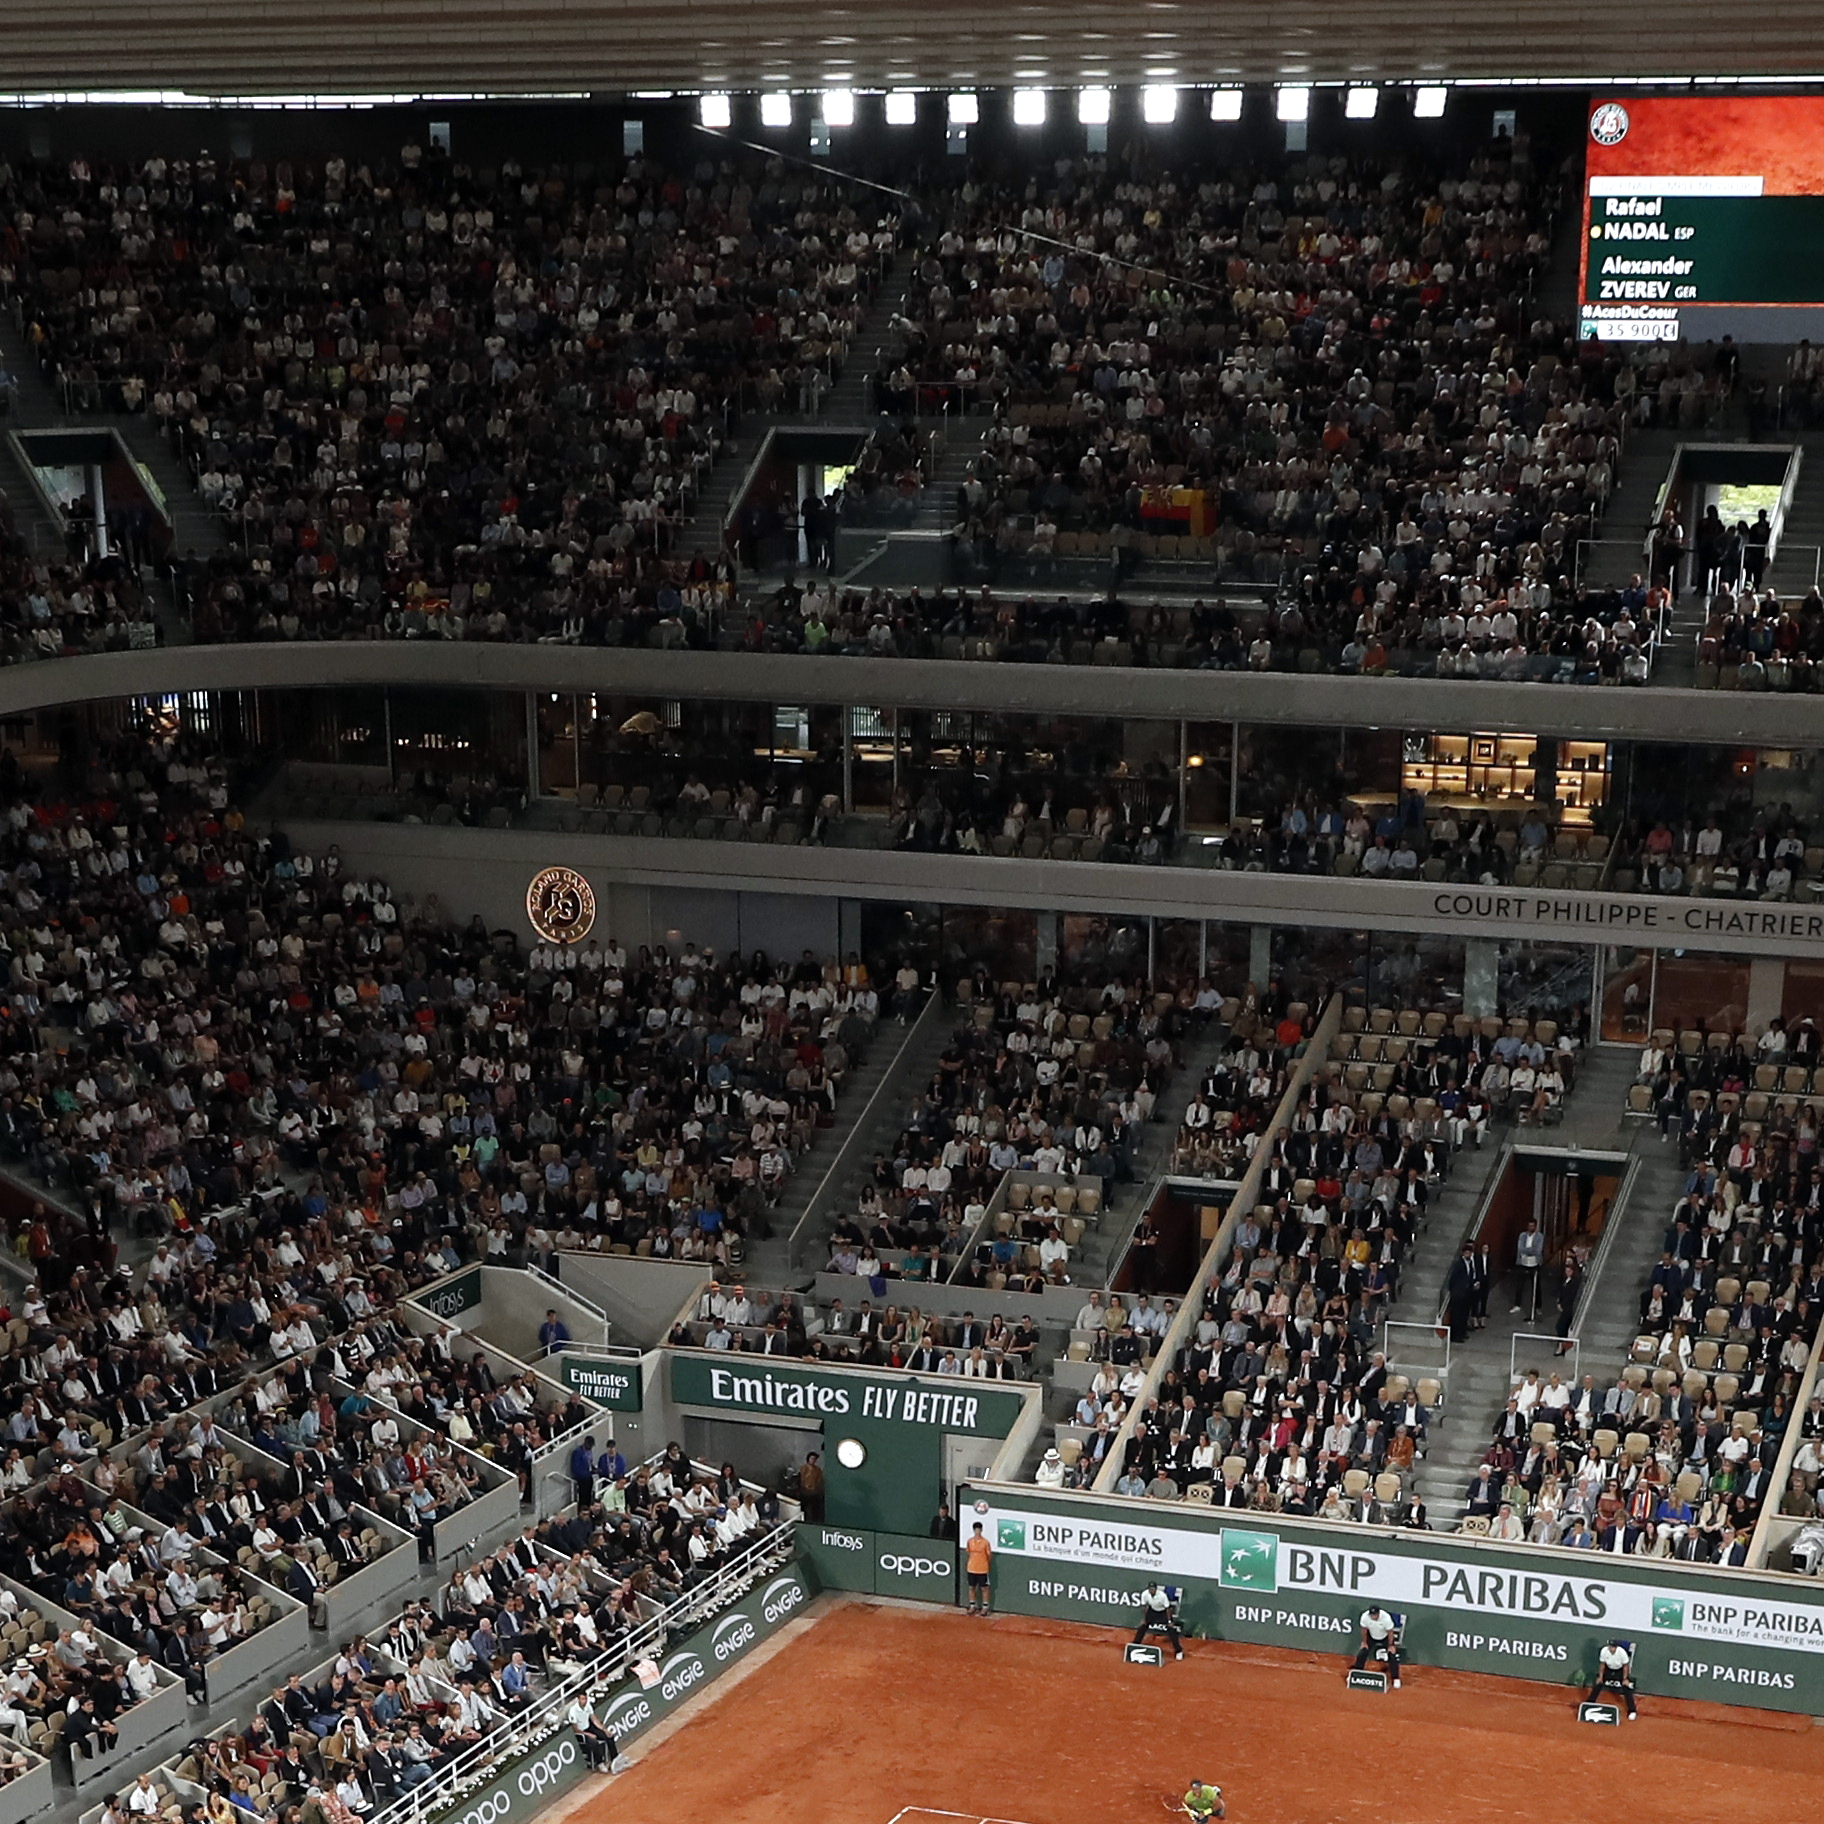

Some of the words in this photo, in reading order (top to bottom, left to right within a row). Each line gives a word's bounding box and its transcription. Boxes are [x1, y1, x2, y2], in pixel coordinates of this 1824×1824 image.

[1606, 199, 1661, 216] Rafael
[1604, 223, 1669, 240] NADAL
[1674, 227, 1694, 239] ESP
[1602, 258, 1693, 274] Alexander
[1600, 282, 1670, 299] ZVEREV
[1674, 286, 1696, 298] GER
[1581, 306, 1677, 320] #AcesDuCoeur
[532, 871, 560, 912] ROLAND
[1434, 894, 1527, 920] COURT
[1536, 901, 1658, 926] PHILIPPE
[1684, 908, 1823, 937] CHATRIER
[429, 1288, 464, 1315] Infosys
[570, 1368, 629, 1389] Emirates
[579, 1384, 593, 1397] FLY
[594, 1384, 621, 1399] BETTER
[710, 1368, 850, 1415] Emirates
[862, 1386, 901, 1419] FLY
[902, 1391, 978, 1429] BETTER
[821, 1530, 864, 1551] Infosys
[1033, 1524, 1073, 1544] BNP
[1079, 1530, 1163, 1556] PARIBAS
[879, 1553, 951, 1577] oppo
[1044, 1546, 1071, 1556] banque
[1092, 1552, 1118, 1560] monde
[1135, 1557, 1163, 1567] change
[1028, 1580, 1064, 1597] BNP
[1068, 1584, 1142, 1607] PARIBAS
[1289, 1549, 1376, 1590] BNP
[1422, 1564, 1606, 1620] PARIBAS
[1235, 1605, 1272, 1624] BNP
[1276, 1610, 1352, 1634] PARIBAS
[1692, 1603, 1737, 1624] BNP
[1692, 1623, 1708, 1633] The
[1711, 1626, 1733, 1635] bank
[1736, 1629, 1750, 1638] for
[1761, 1632, 1805, 1645] changing
[1445, 1631, 1485, 1651] BNP
[1489, 1635, 1567, 1661] PARIBAS
[1351, 1676, 1384, 1688] LACOSTE
[1668, 1659, 1708, 1678] BNP
[1712, 1665, 1795, 1689] PARIBAS
[518, 1740, 576, 1796] oppo
